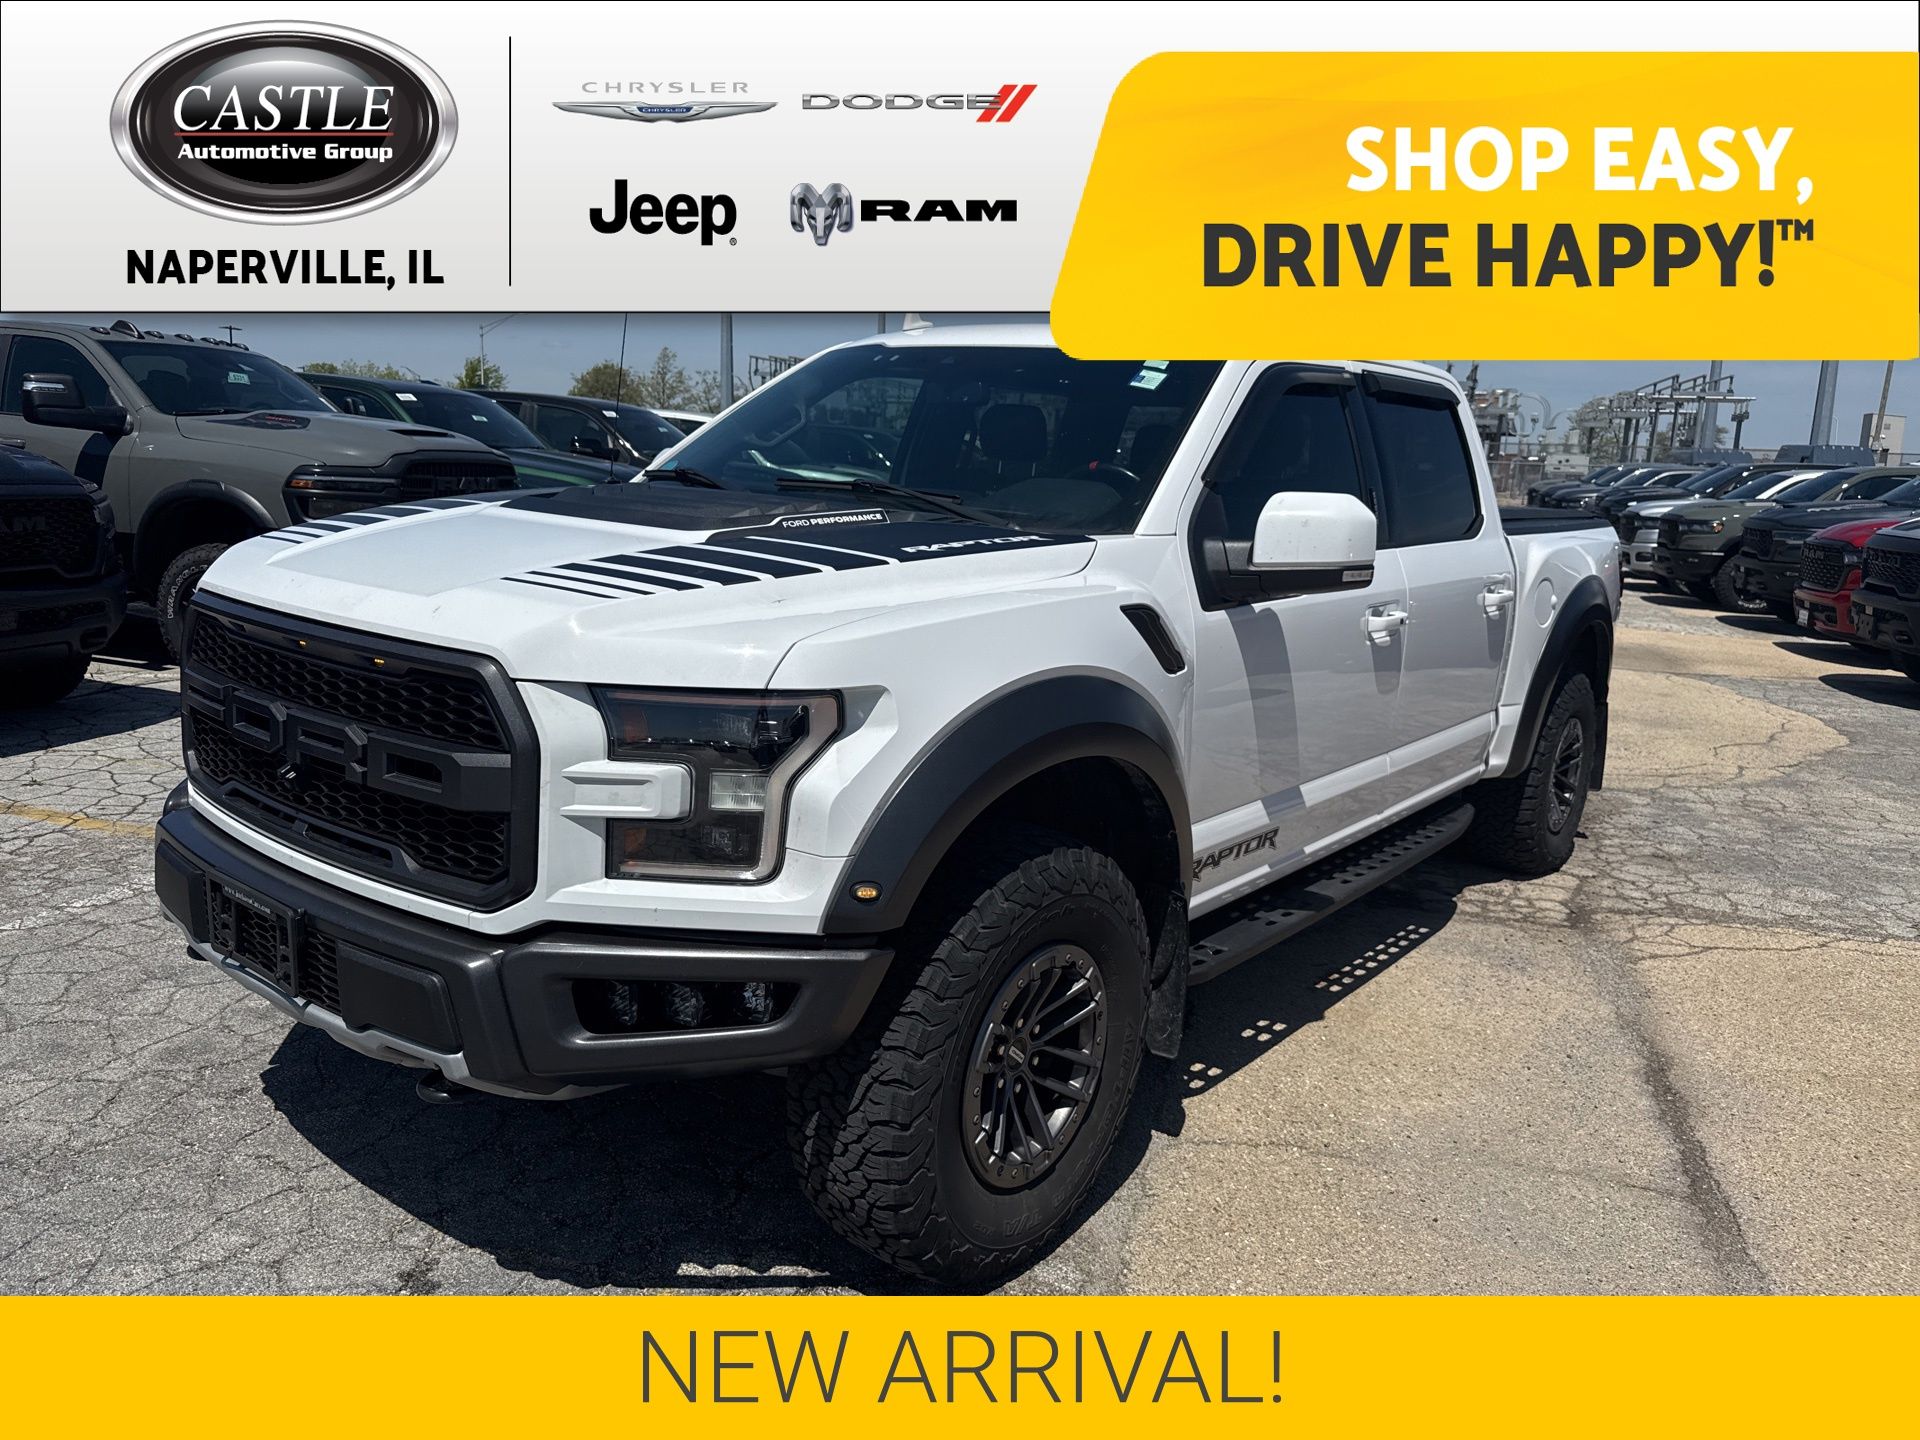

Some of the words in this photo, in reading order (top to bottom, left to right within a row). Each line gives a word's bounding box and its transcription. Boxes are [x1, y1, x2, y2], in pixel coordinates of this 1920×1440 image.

[782, 519, 810, 528] FORD
[810, 513, 883, 525] PERFORMANCE
[900, 535, 1055, 553] RAPTOR
